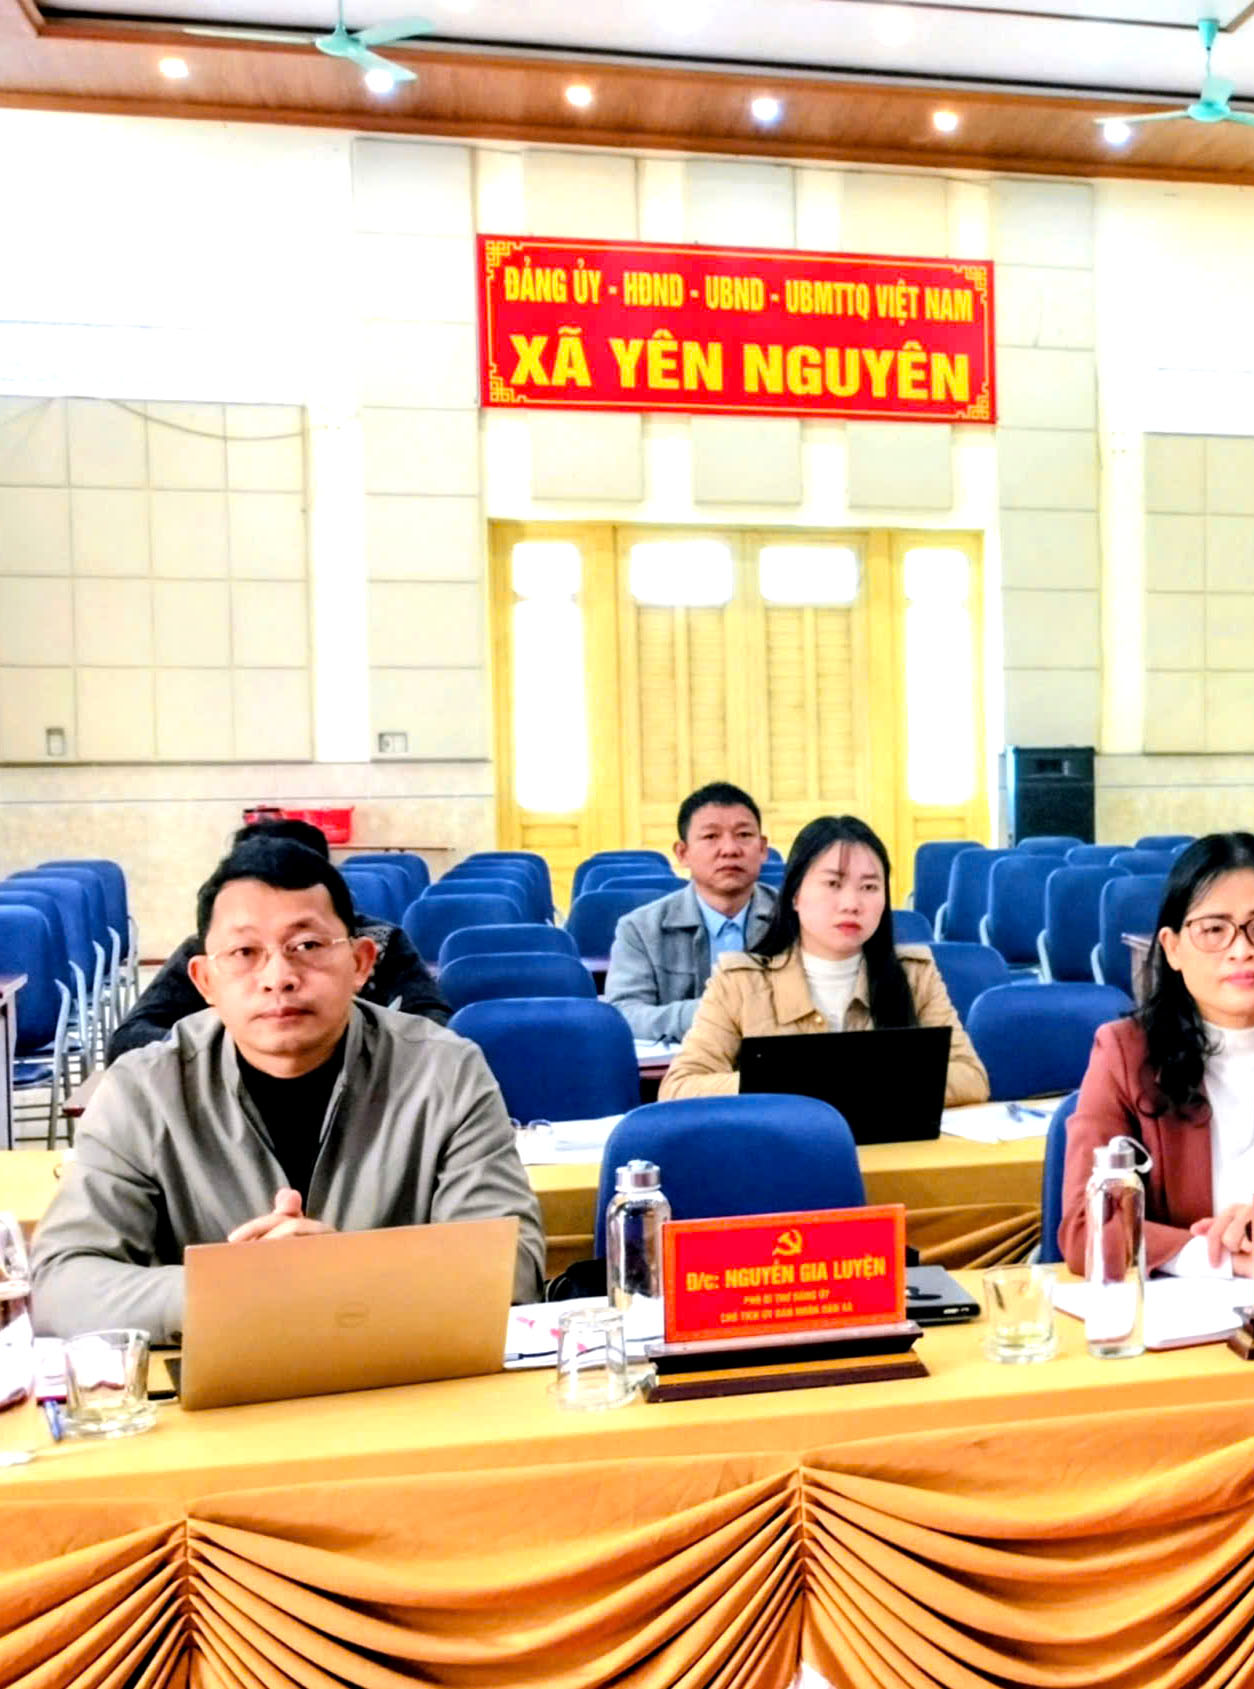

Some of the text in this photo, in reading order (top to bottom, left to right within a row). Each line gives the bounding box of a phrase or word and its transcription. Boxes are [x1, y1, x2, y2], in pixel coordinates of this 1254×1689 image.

[504, 255, 974, 326] ĐẢNG ỦY - HĐND - UBND - UBMTTQ VIỆT NAM
[510, 326, 970, 402] XÃ YÊN NGUYÊN
[685, 1272, 720, 1292] Đ/c:
[799, 1262, 829, 1283] GIA
[833, 1253, 886, 1280] LUYỆN
